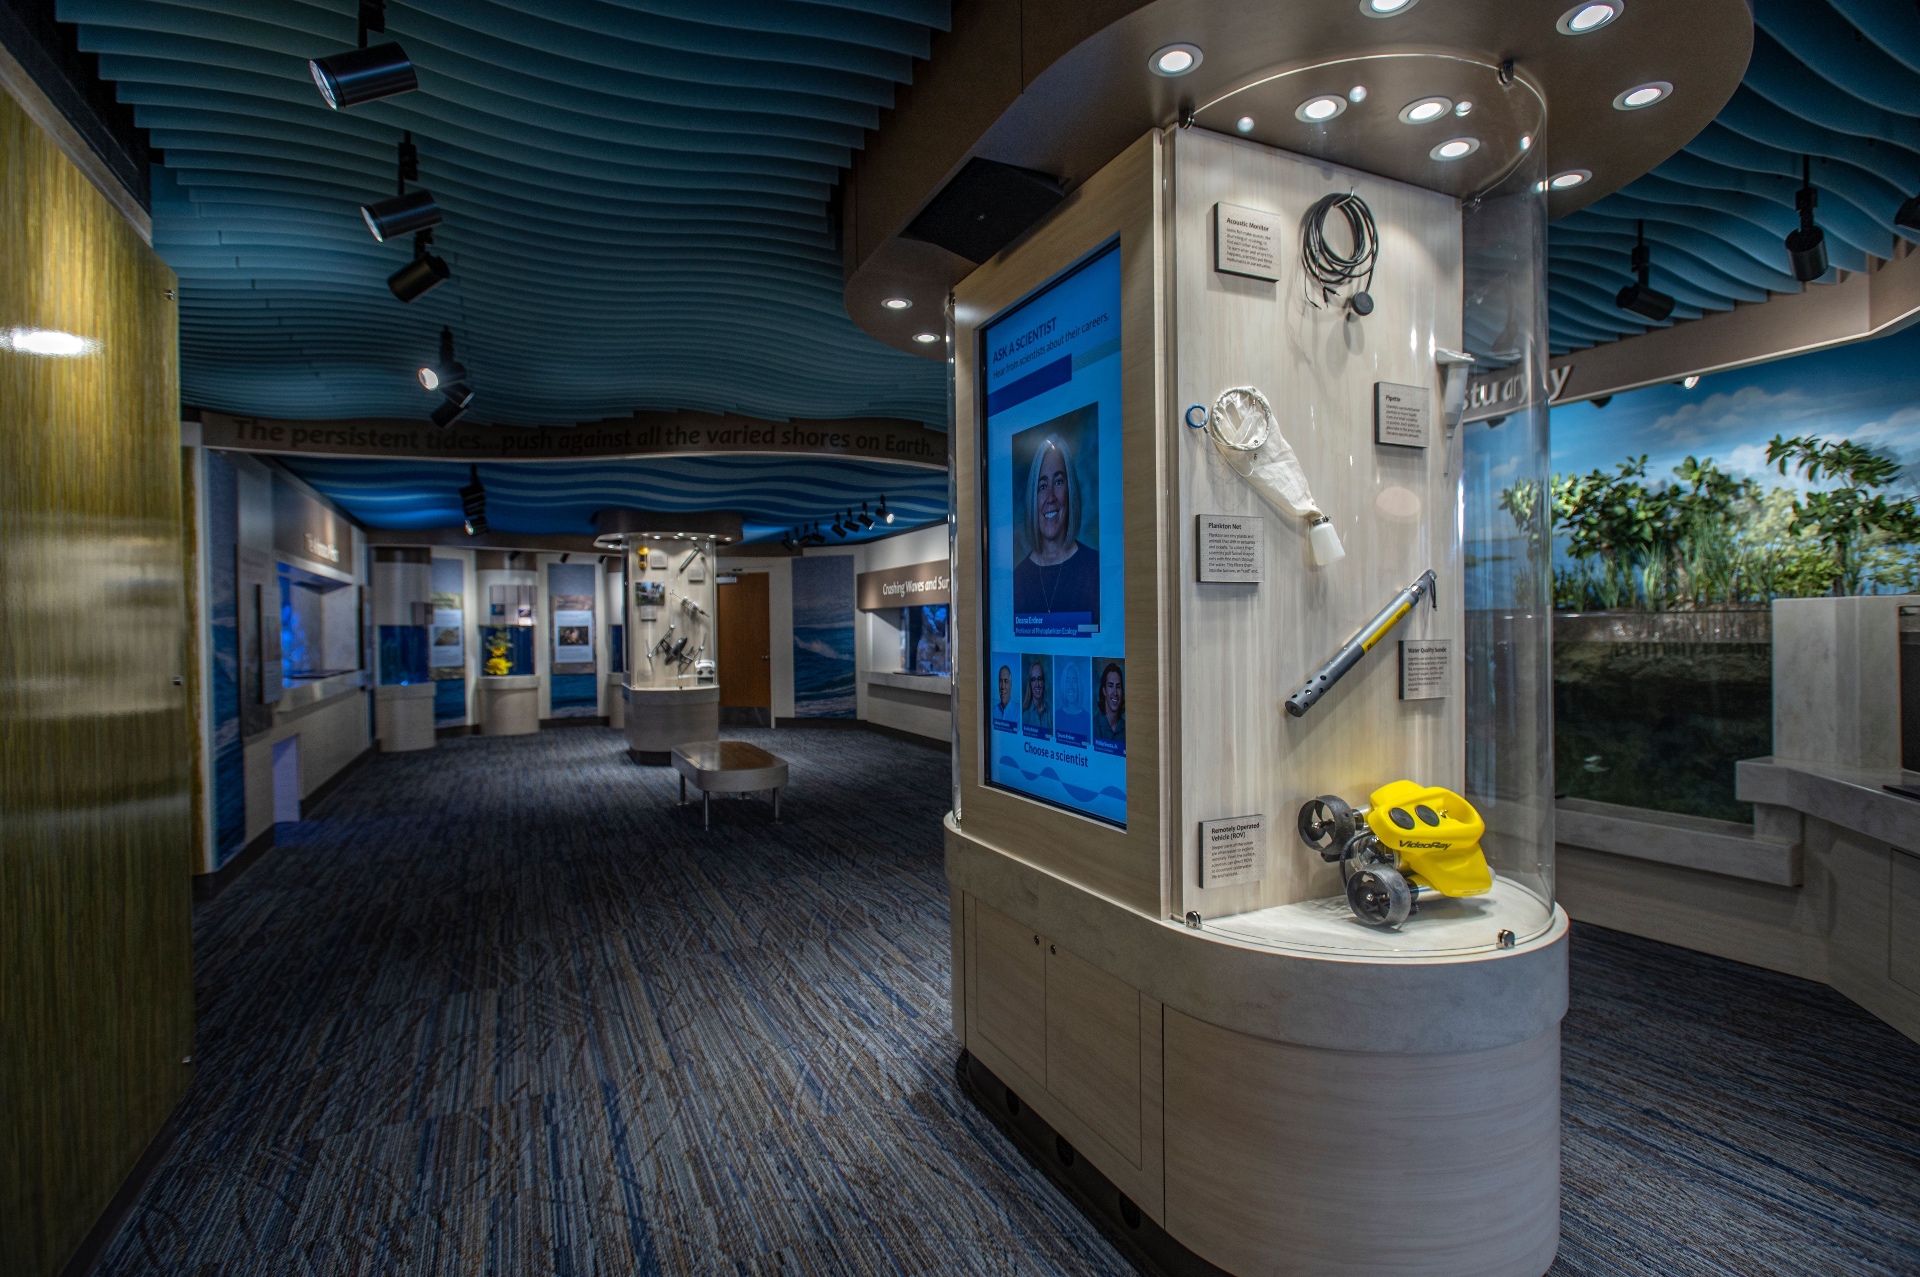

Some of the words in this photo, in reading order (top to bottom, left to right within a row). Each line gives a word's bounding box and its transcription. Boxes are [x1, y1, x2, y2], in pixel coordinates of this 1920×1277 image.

[1227, 218, 1247, 227] Acoustic
[1249, 223, 1269, 231] Monitor
[993, 346, 1008, 364] ASK
[1009, 341, 1014, 353] A
[1016, 317, 1056, 348] SCIENTIST
[993, 366, 1004, 380] Hear
[1006, 358, 1019, 373] from
[1019, 345, 1045, 366] scientists
[1046, 334, 1064, 352] about
[1065, 326, 1080, 343] their
[1082, 312, 1109, 333] careers.
[233, 419, 284, 442] The
[291, 426, 420, 448] persistent
[558, 428, 631, 454] against
[636, 425, 662, 447] all
[666, 425, 699, 446] the
[706, 425, 775, 445] varied
[781, 426, 850, 448] shores
[856, 434, 880, 450] on
[886, 434, 935, 456] Earth.
[883, 583, 905, 598] Crashing
[906, 580, 924, 592] Waves
[925, 576, 937, 590] and
[938, 576, 950, 592] Sur
[1029, 616, 1043, 624] Erdner
[1024, 741, 1049, 758] Choose
[1050, 750, 1055, 760] a
[1056, 750, 1088, 768] scientist
[1212, 826, 1235, 834] Remotely
[1236, 822, 1260, 830] Operated
[1231, 832, 1245, 840] (ROV)
[1399, 840, 1452, 850] VideoRay
